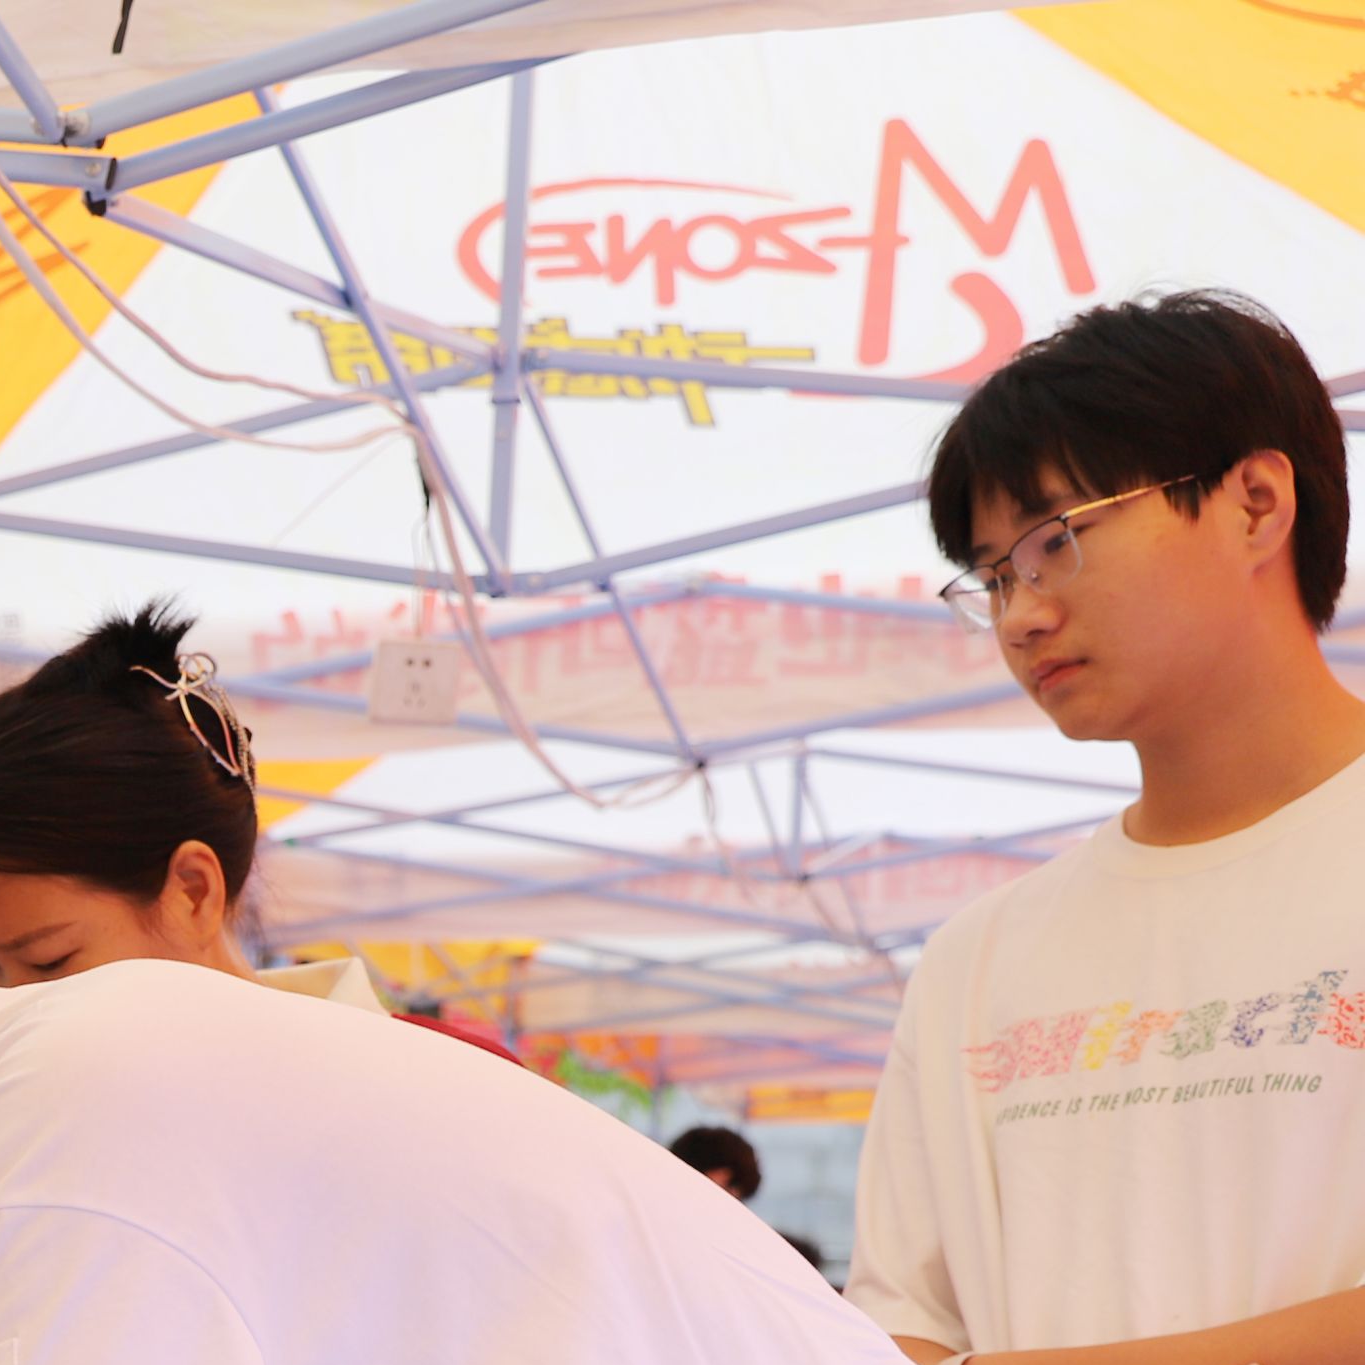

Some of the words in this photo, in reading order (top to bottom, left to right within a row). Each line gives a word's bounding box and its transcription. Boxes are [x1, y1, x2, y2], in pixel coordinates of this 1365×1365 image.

[1087, 1093, 1118, 1114] THE
[1171, 1075, 1255, 1105] BEAUTIFUL
[1261, 1072, 1322, 1094] THING
